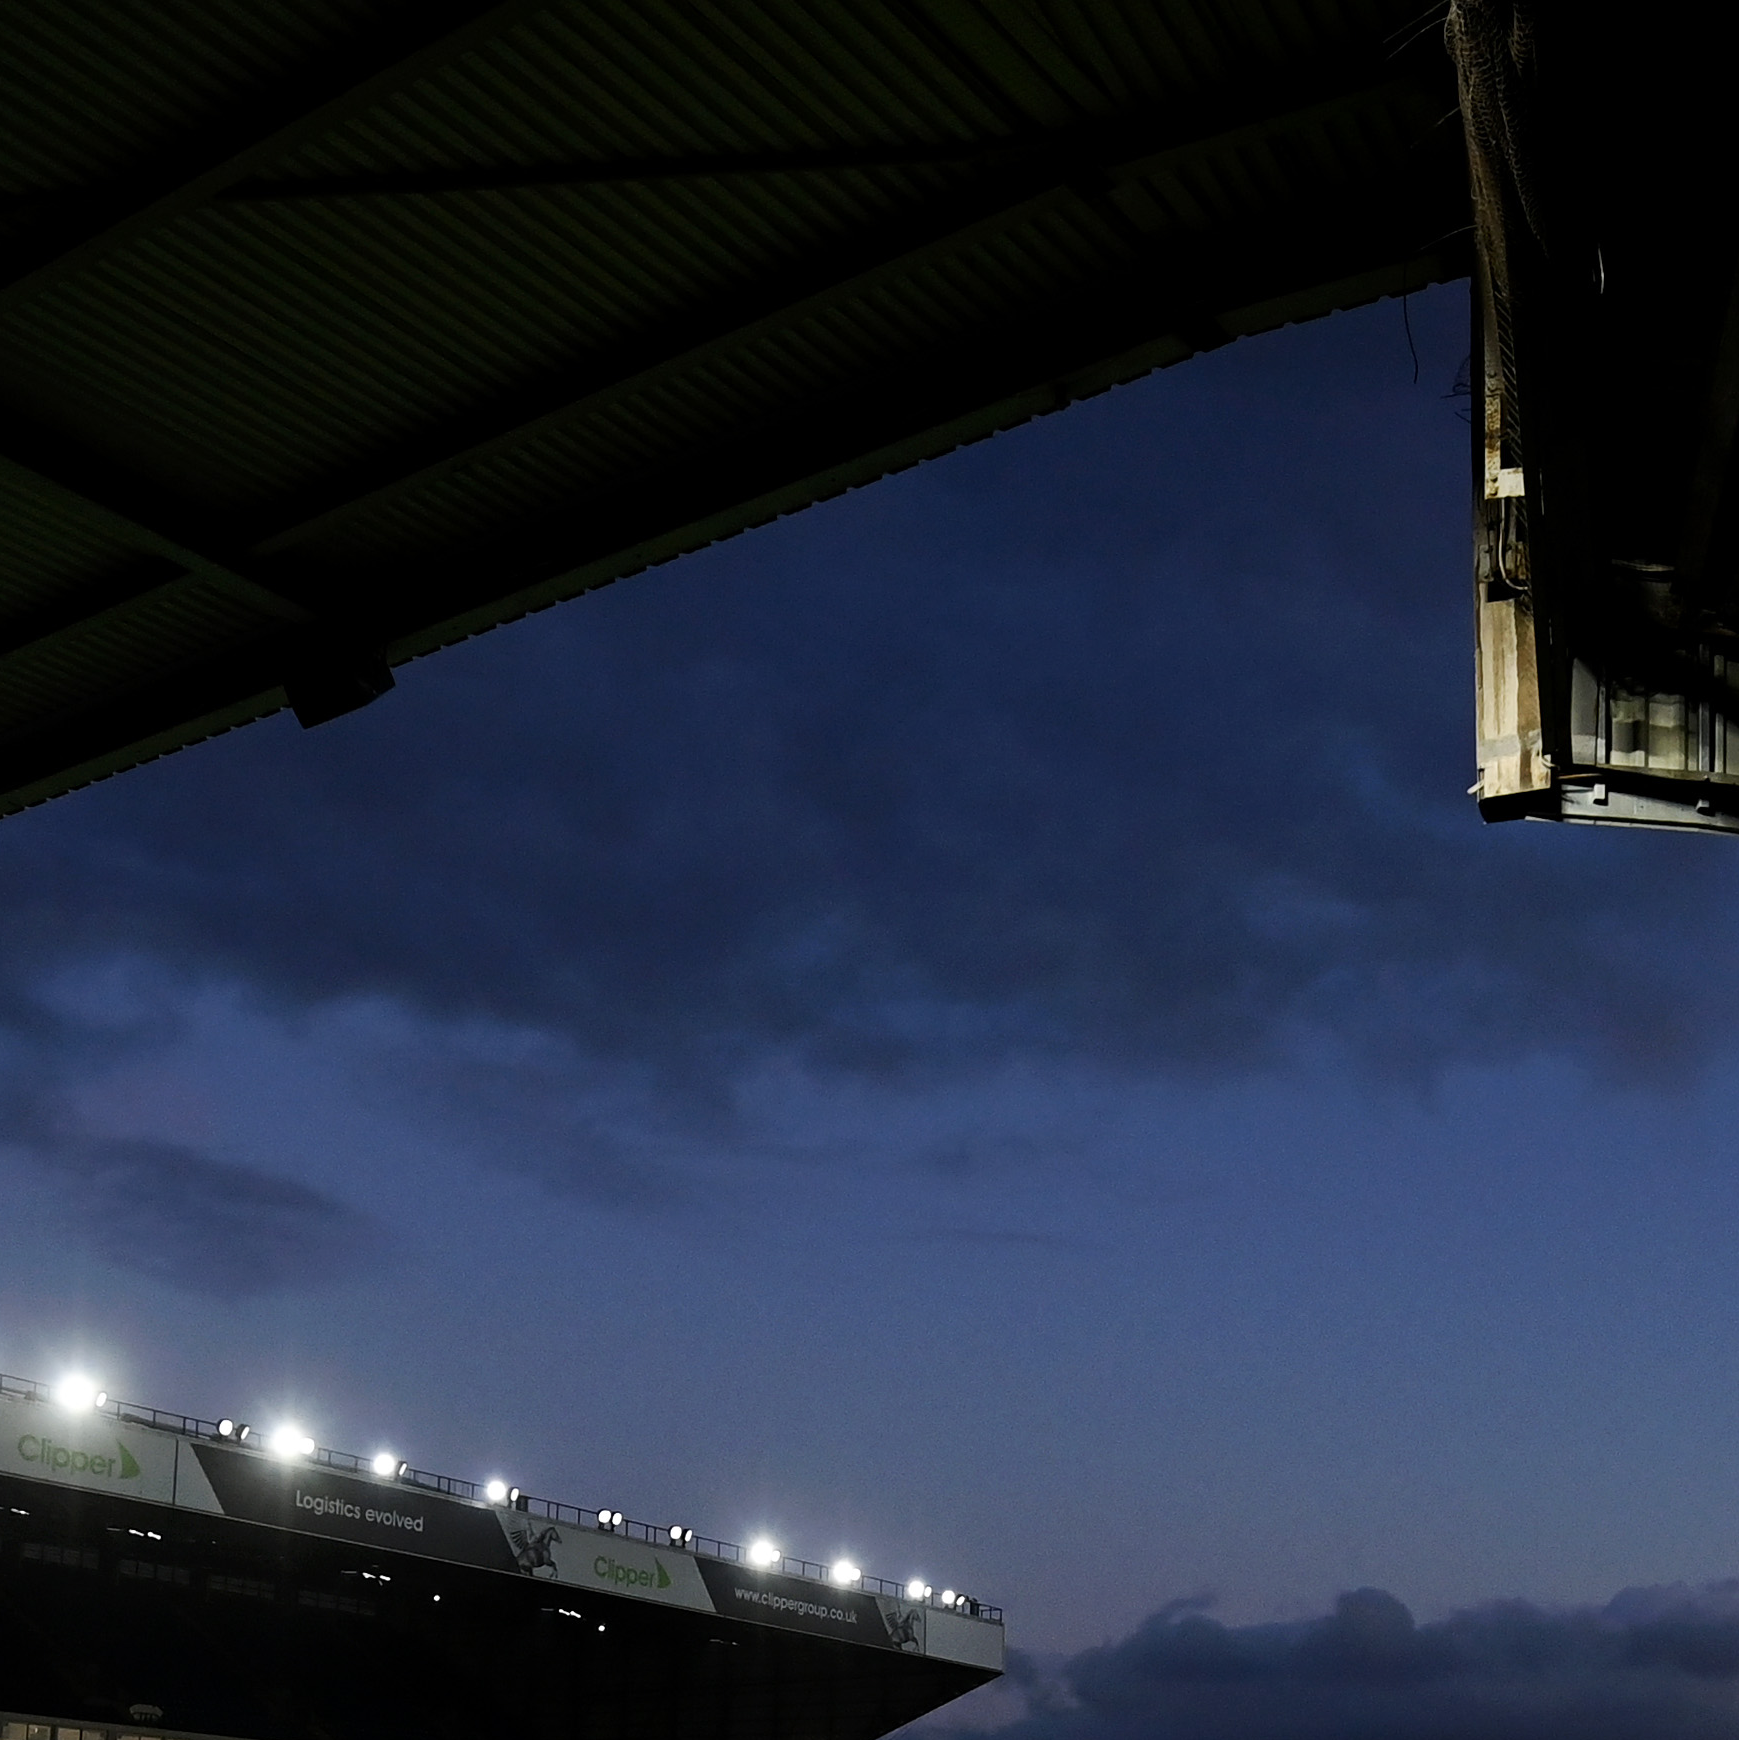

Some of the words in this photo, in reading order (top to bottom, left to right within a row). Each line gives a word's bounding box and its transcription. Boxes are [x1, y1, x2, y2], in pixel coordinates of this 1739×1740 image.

[17, 1432, 118, 1480] Clipper
[295, 1488, 361, 1522] Logistics
[365, 1503, 425, 1533] evolved
[592, 1554, 657, 1589] Clipper
[734, 1585, 859, 1626] www.clippergroup.co.uk
